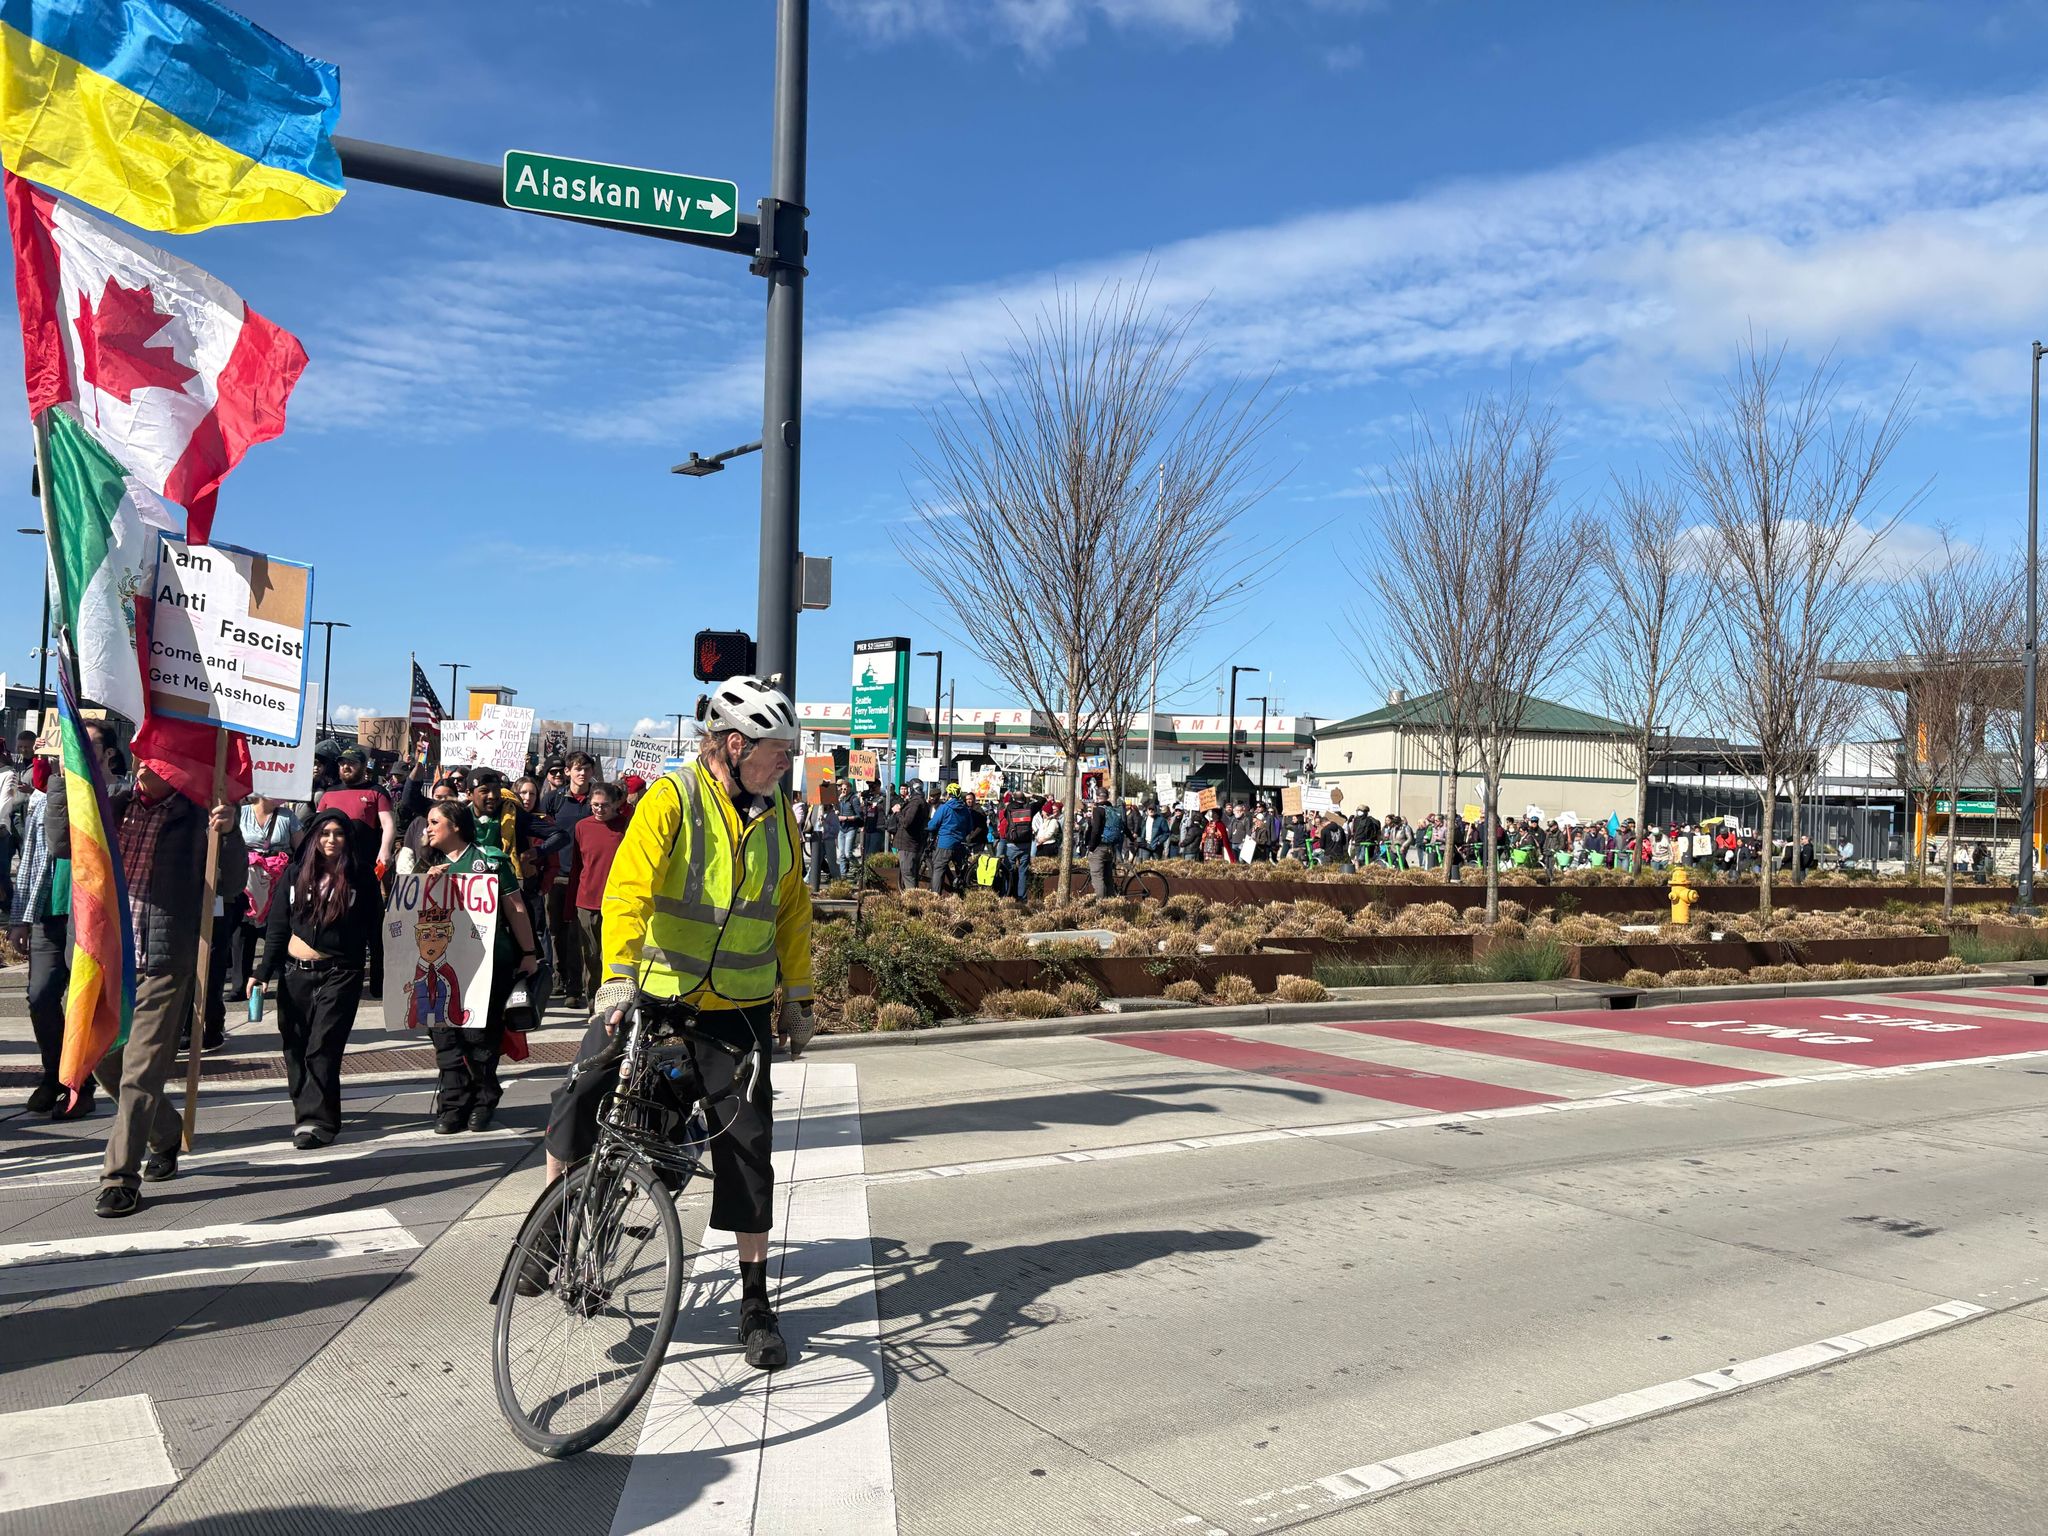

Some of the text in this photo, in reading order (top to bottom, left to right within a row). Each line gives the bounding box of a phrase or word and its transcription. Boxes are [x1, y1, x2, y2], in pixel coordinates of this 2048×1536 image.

[514, 165, 691, 220] Alaskan Wy
[163, 545, 212, 573] I am
[158, 585, 206, 612] Anti
[220, 619, 303, 659] Fascist
[857, 643, 867, 651] PIER
[151, 641, 237, 671] Come and
[150, 668, 285, 711] Get Me Assholes
[855, 696, 872, 704] Seattle
[484, 706, 532, 720] WE SPEAK
[855, 705, 888, 716] Ferry Terminal
[361, 720, 407, 735] I STAND
[442, 721, 479, 731] YOUR WAR
[500, 730, 526, 741] FIGHT
[386, 736, 400, 750] MY
[502, 740, 527, 752] VOTE
[631, 739, 668, 753] DEMOCRACY
[443, 746, 464, 757] YOUR
[634, 750, 661, 763] NEEDS
[850, 753, 872, 764] NO FAUX
[631, 759, 657, 772] YOUR
[850, 765, 862, 776] KING
[387, 874, 419, 912] NO
[422, 873, 498, 914] KINGS
[1819, 1013, 1982, 1032] BUS
[1666, 1020, 1874, 1045] ONLY
